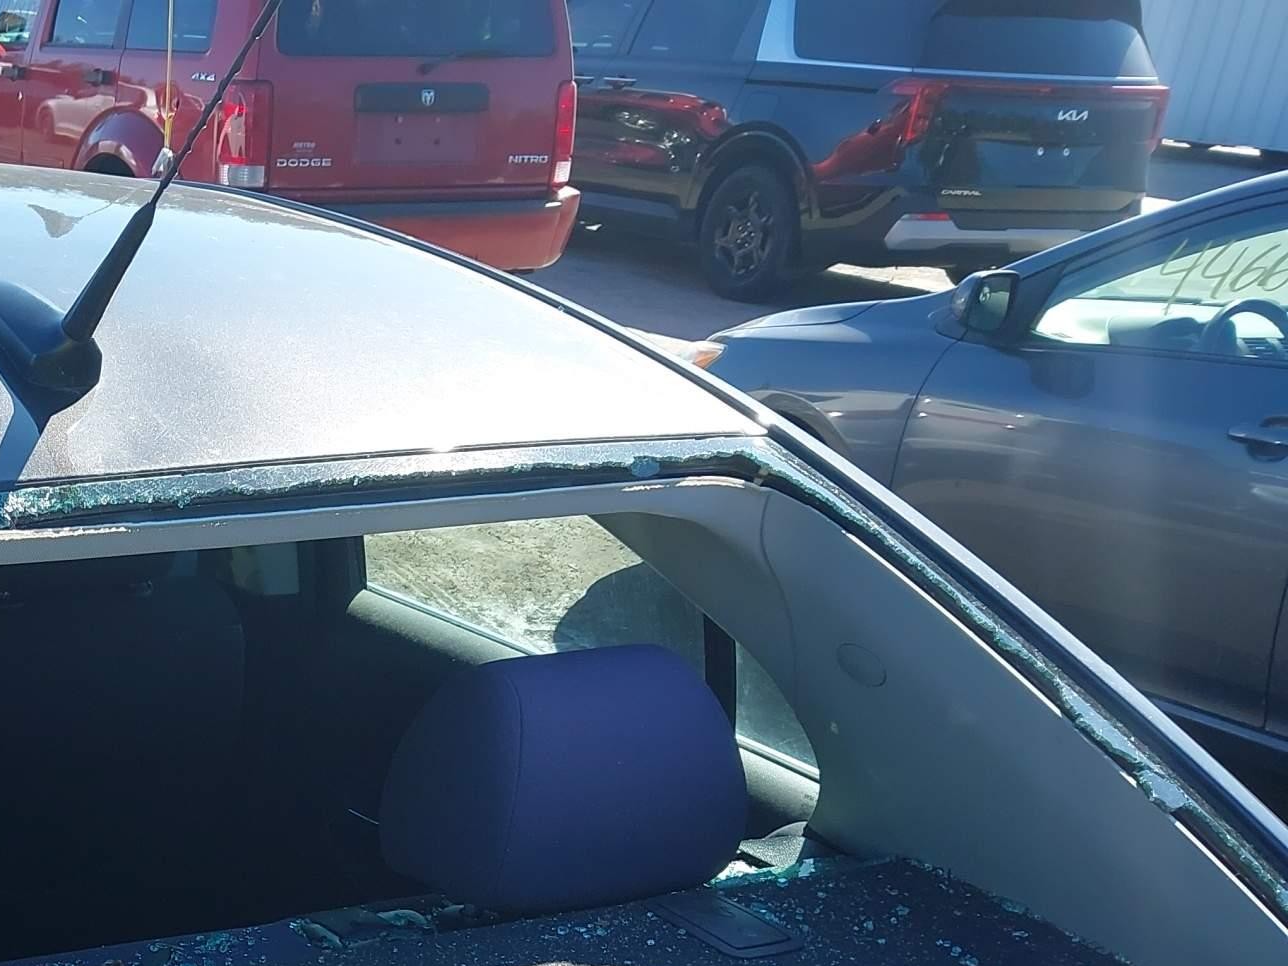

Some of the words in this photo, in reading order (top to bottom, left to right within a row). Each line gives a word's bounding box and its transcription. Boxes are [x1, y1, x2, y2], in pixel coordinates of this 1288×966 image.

[1057, 109, 1089, 121] KIA
[276, 158, 332, 167] DODGE
[508, 155, 549, 164] NITRO
